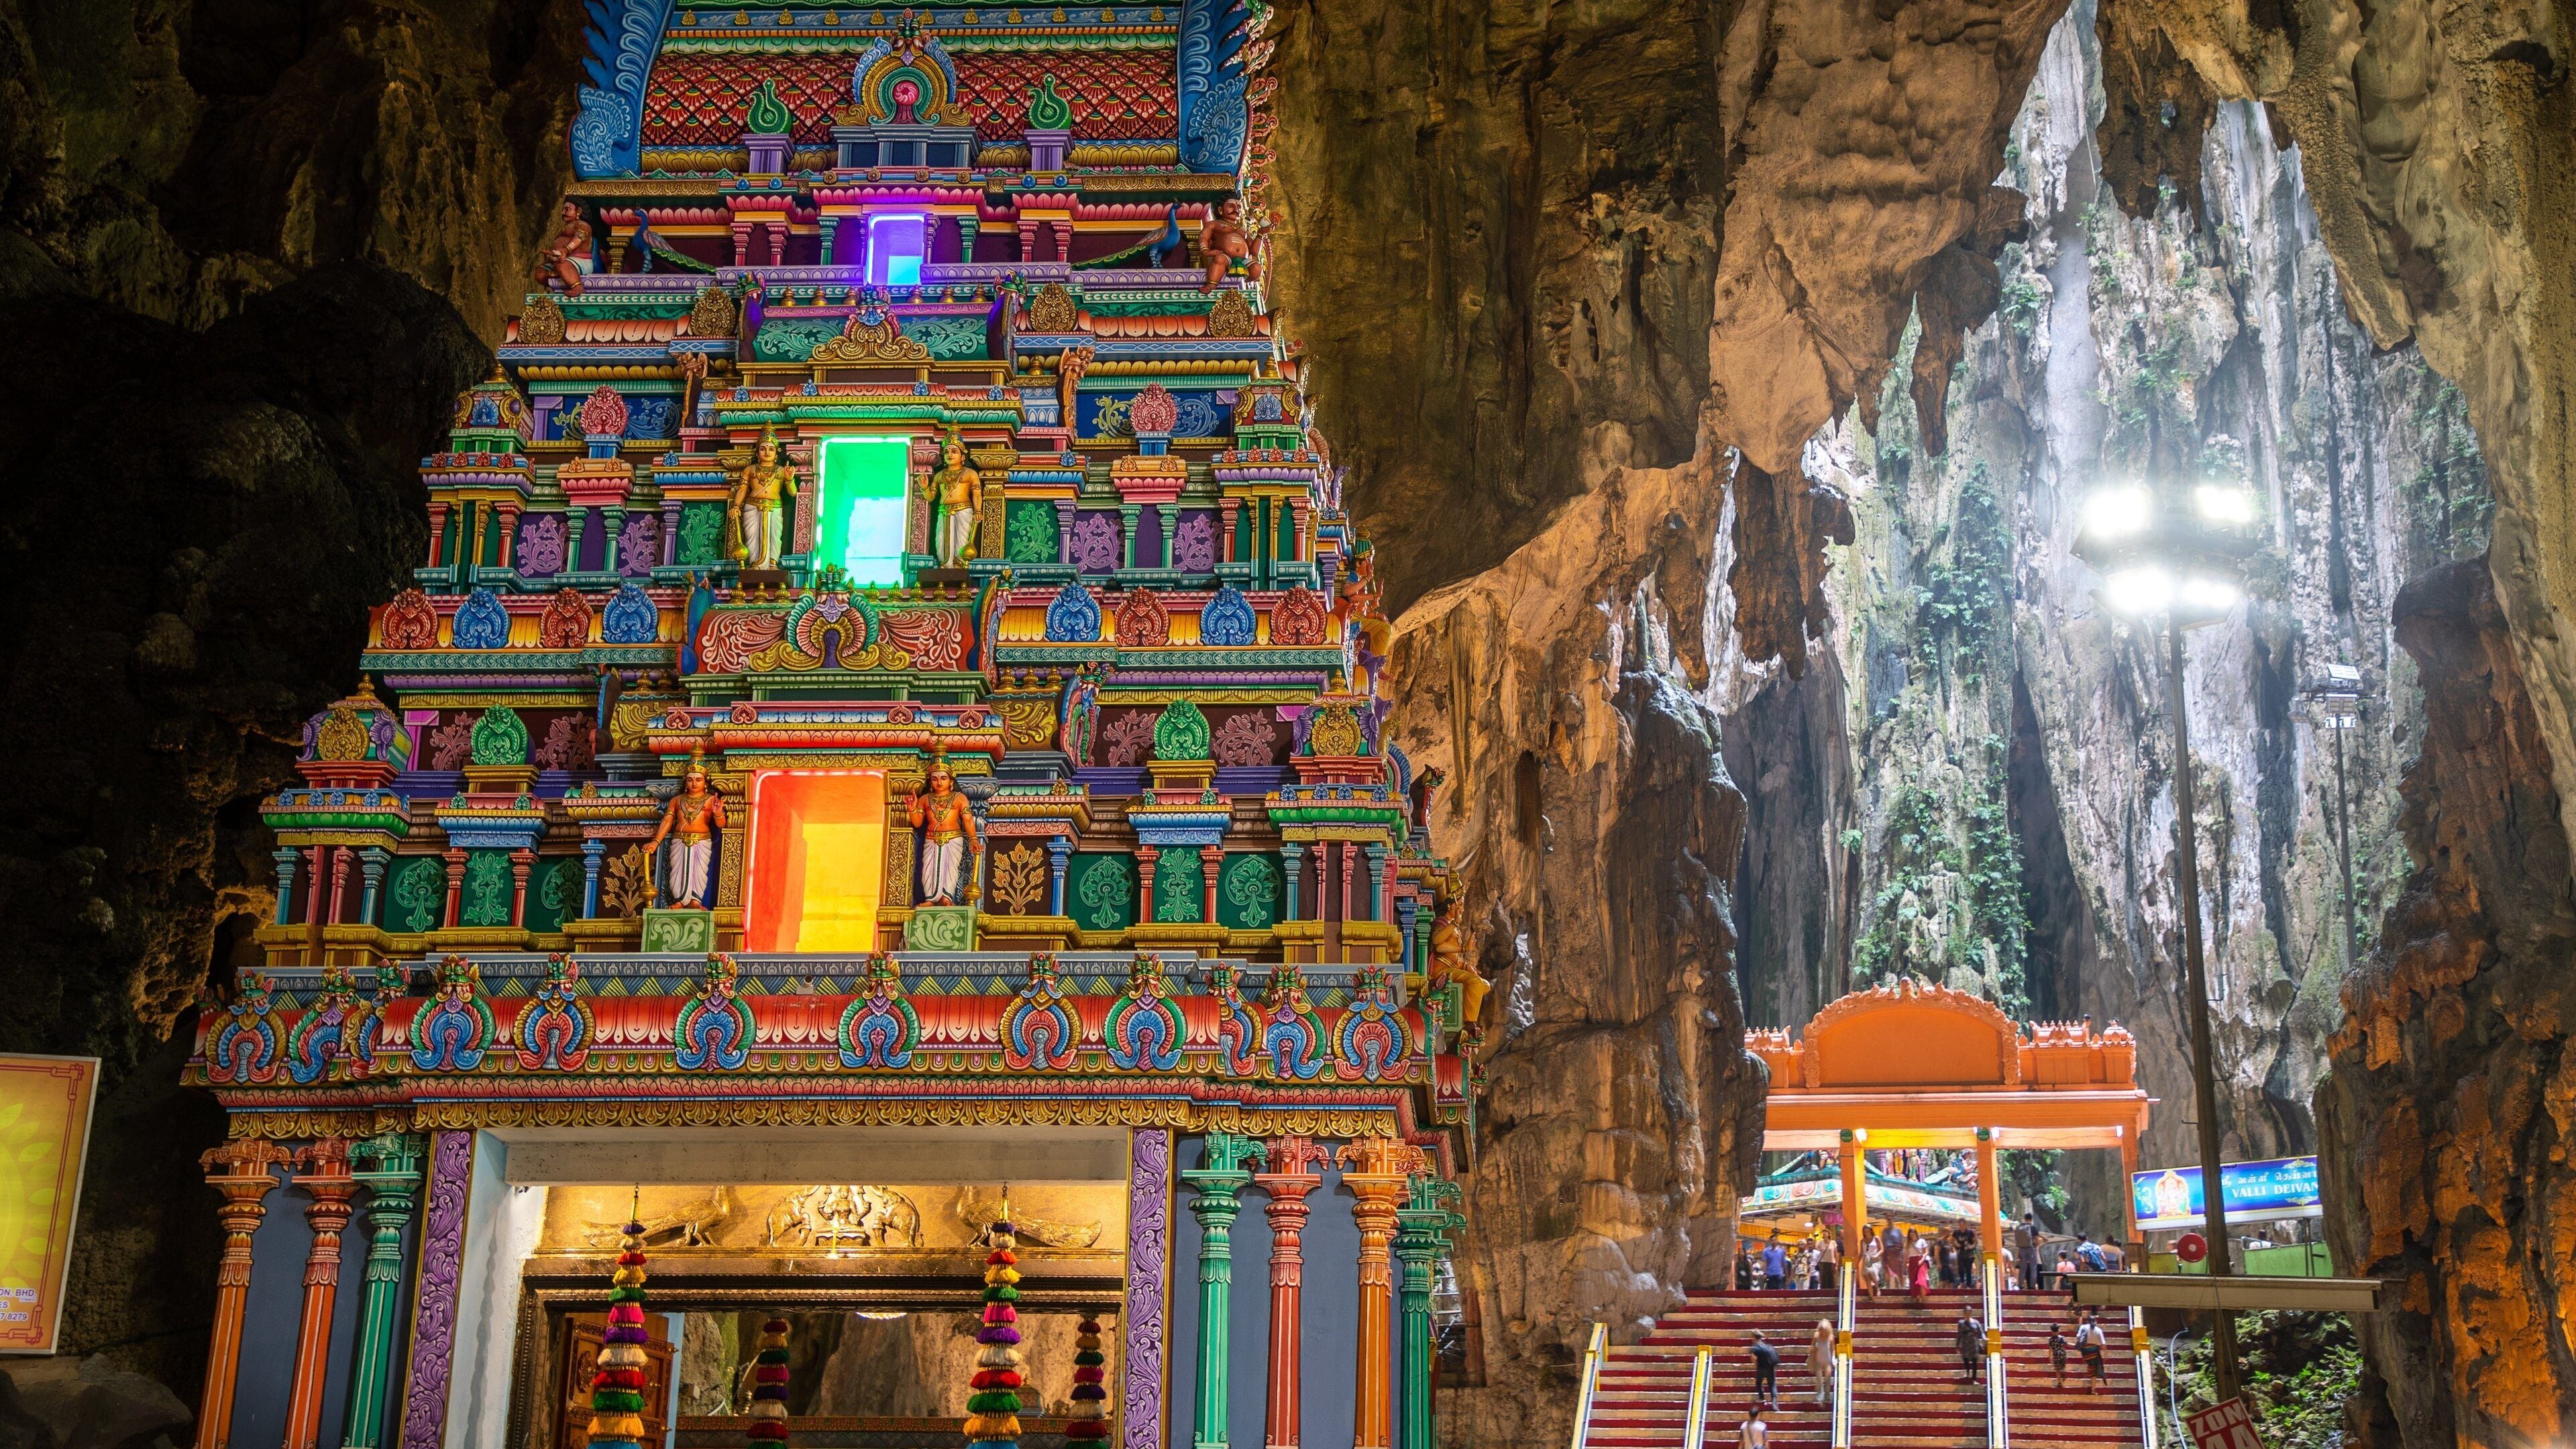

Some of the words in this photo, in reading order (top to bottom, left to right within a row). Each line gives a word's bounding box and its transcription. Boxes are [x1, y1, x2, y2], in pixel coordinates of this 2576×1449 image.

[2232, 1186, 2267, 1198] VALLI
[15, 1289, 36, 1297] BHD.
[2190, 1402, 2247, 1438] ZON
